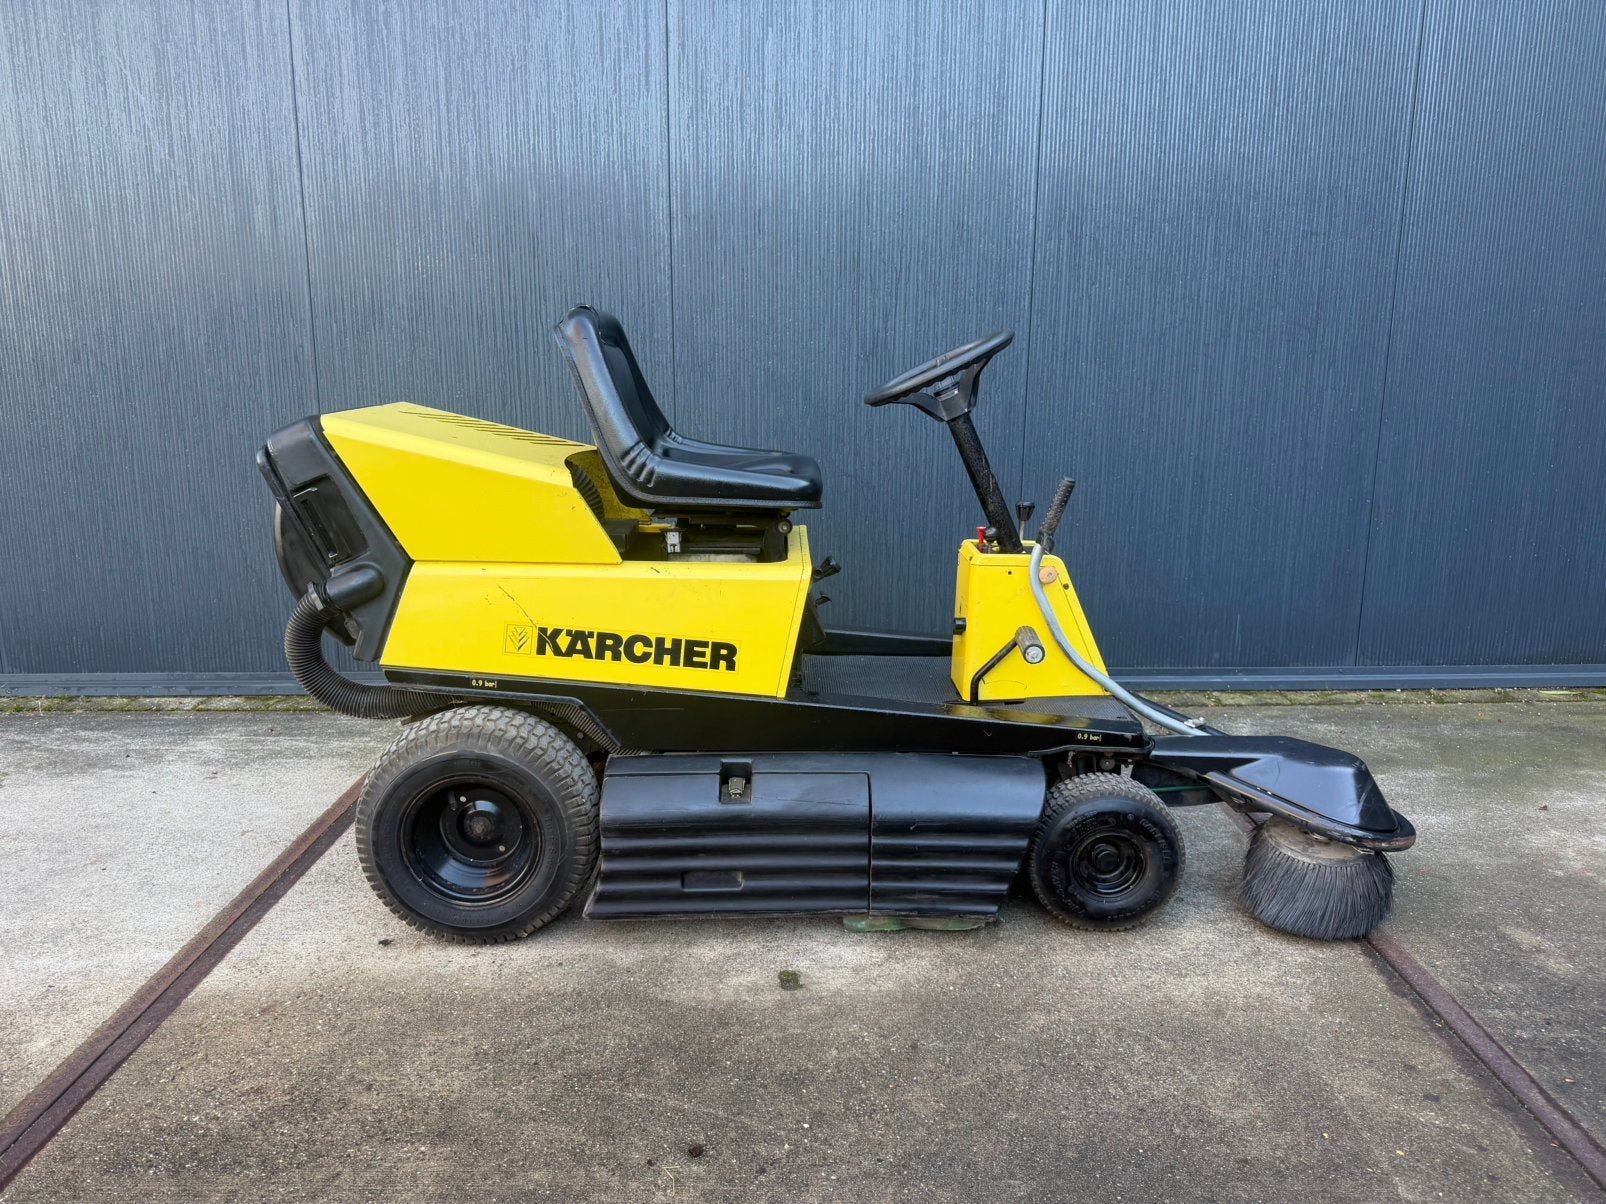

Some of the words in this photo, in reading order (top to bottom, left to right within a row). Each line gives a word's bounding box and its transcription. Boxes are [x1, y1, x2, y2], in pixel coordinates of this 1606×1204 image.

[536, 626, 738, 672] KÄRCHER
[471, 679, 483, 687] 0.9
[1077, 732, 1088, 740] 0.9
